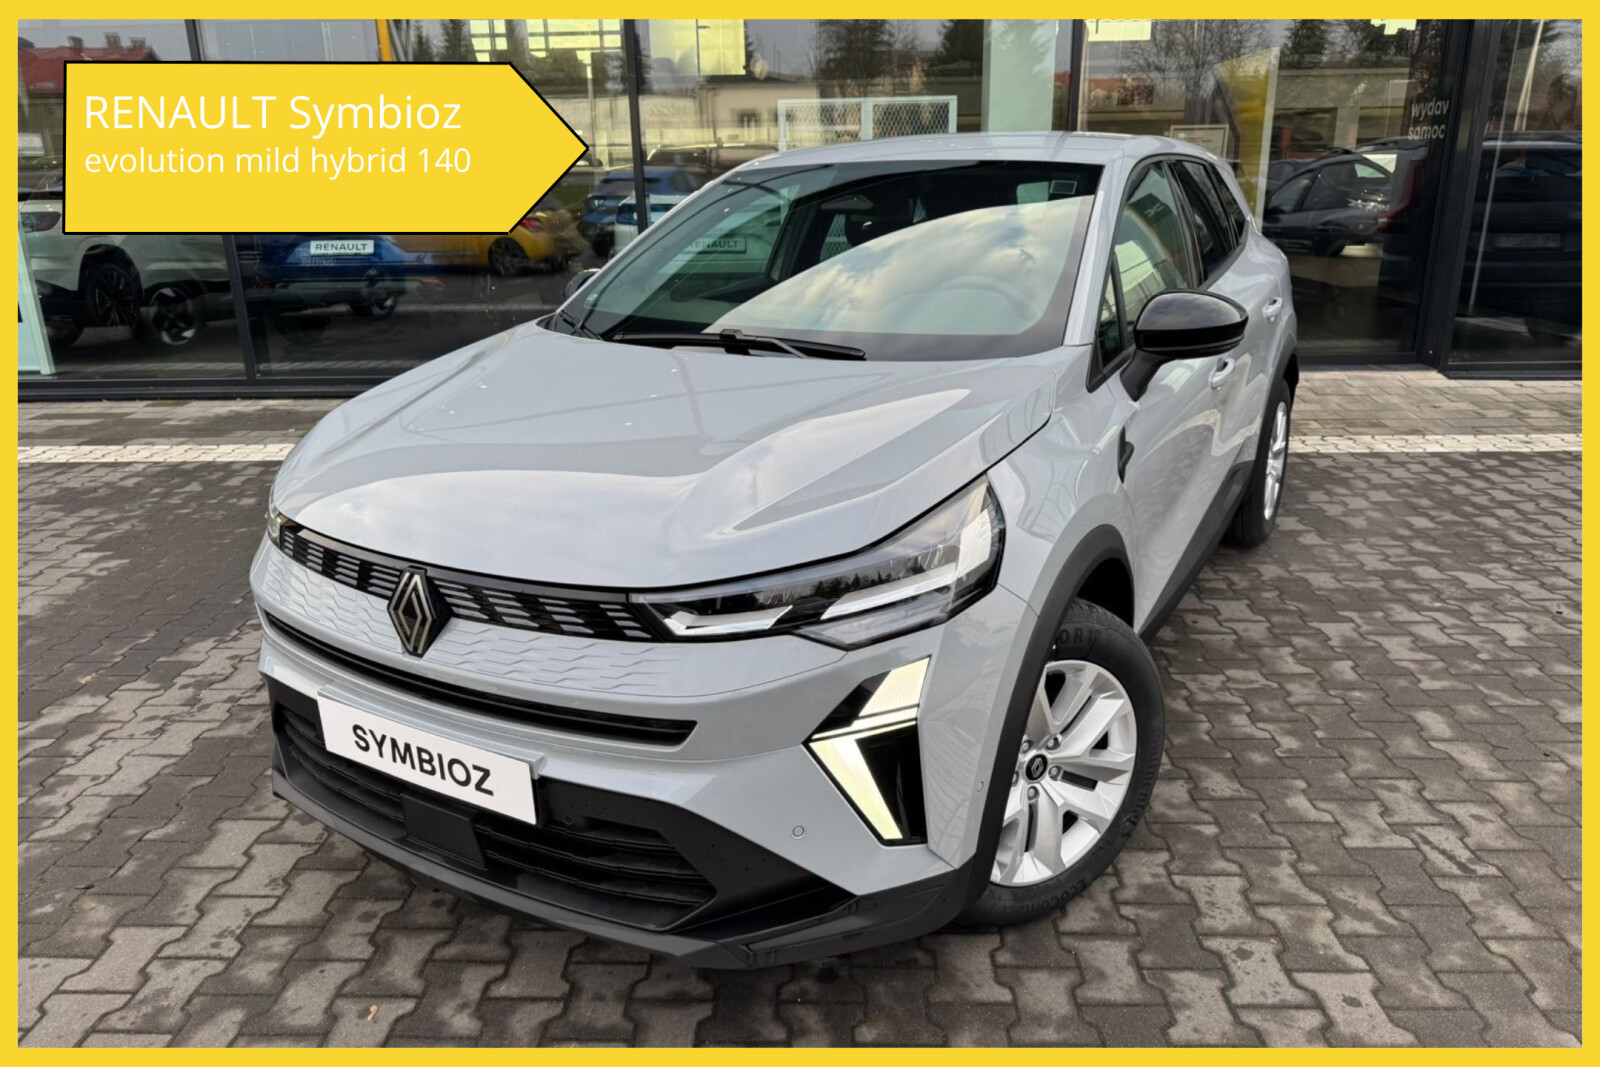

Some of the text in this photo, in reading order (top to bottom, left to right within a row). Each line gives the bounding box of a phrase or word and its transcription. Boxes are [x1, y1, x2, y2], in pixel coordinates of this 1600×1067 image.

[1408, 124, 1446, 141] samoc
[313, 242, 369, 252] RENAULT
[352, 723, 494, 797] SYMBIOZ
